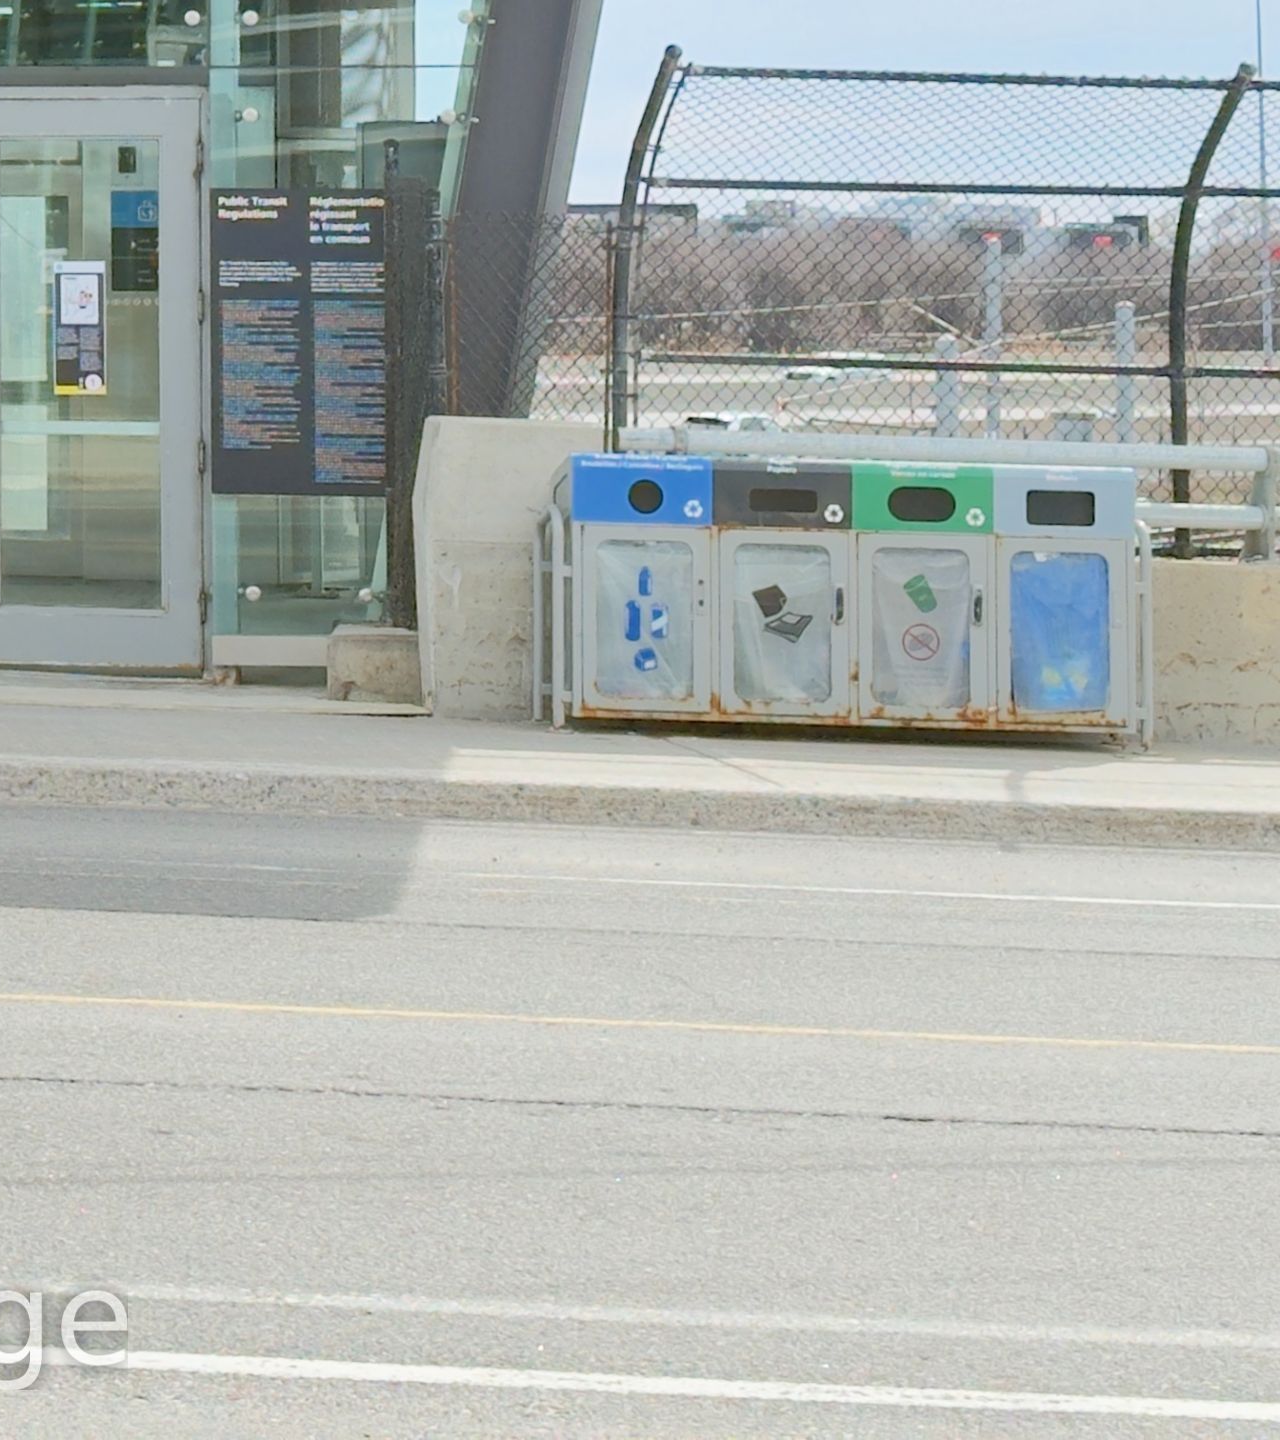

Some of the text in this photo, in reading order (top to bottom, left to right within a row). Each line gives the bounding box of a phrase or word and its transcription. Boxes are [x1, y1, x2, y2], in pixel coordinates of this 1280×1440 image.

[217, 196, 288, 207] Public Transit
[309, 196, 385, 209] Réglementatio
[217, 209, 279, 221] Regulations
[309, 221, 371, 234] le transport
